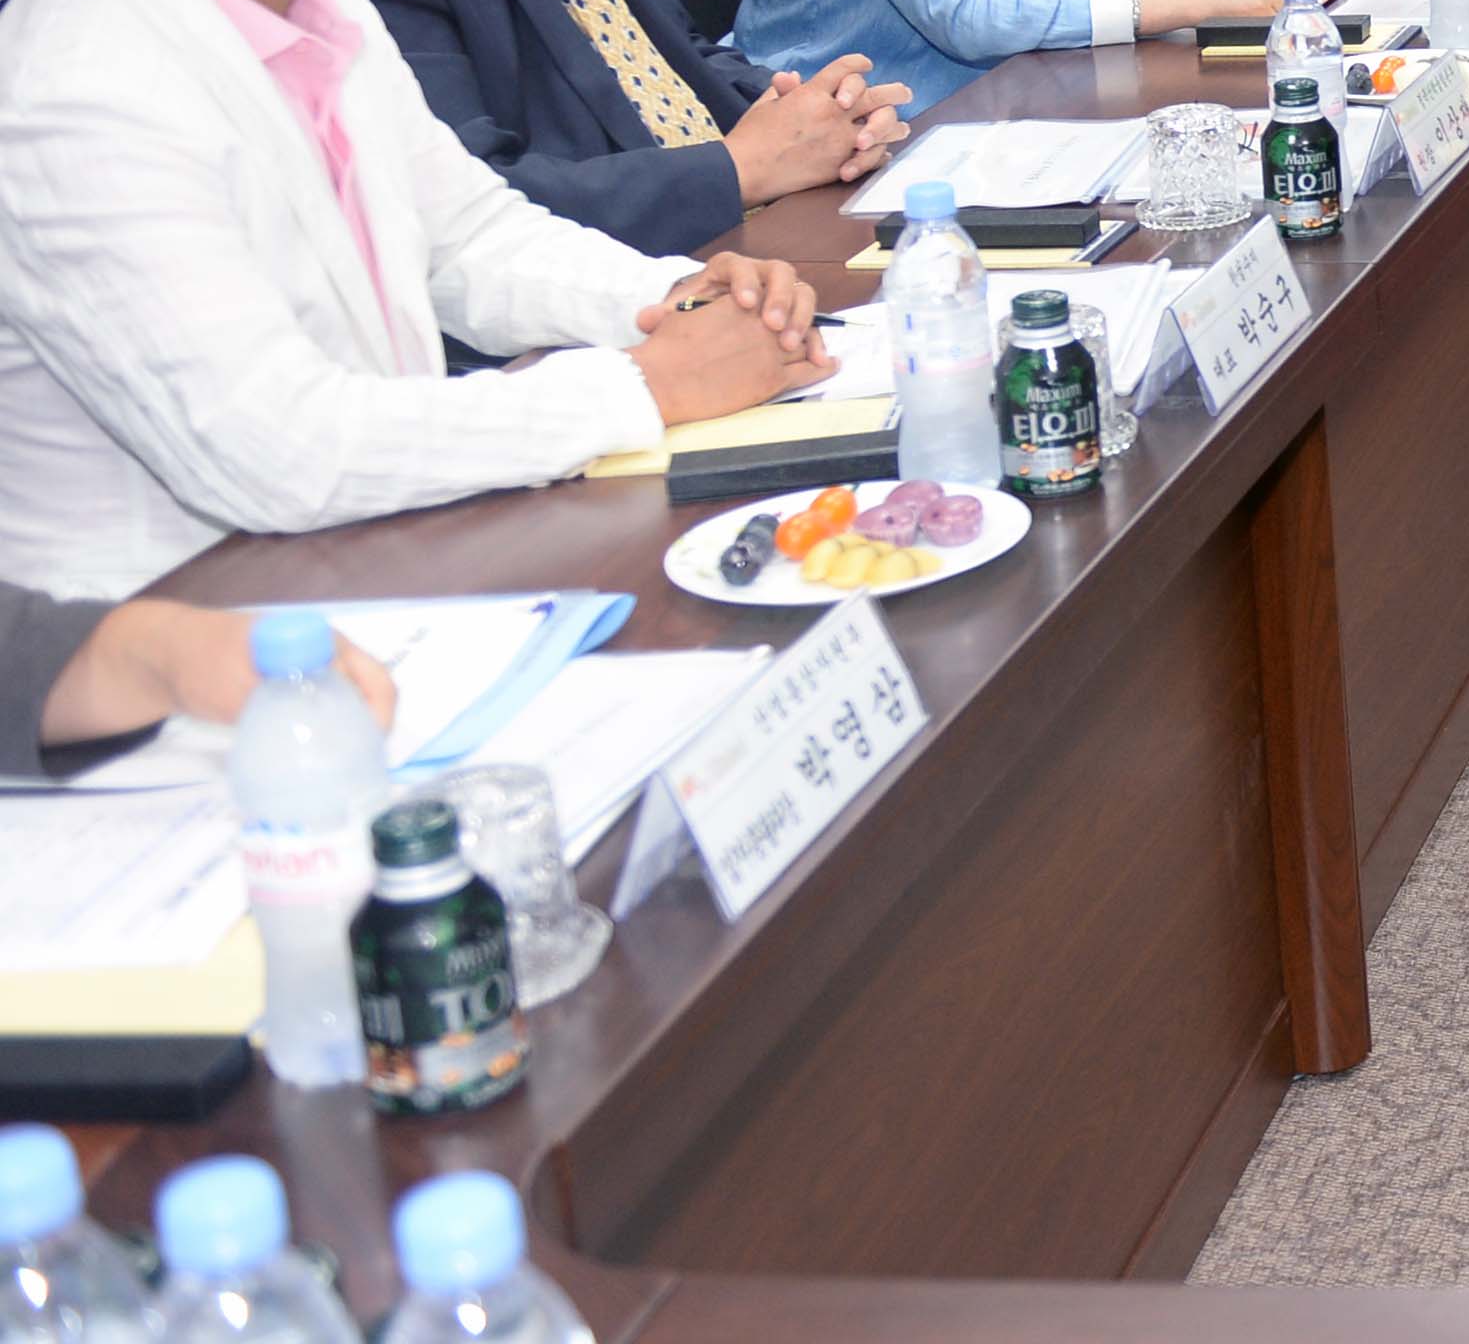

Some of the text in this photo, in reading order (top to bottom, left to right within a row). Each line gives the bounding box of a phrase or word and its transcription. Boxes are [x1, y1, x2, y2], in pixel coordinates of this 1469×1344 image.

[1284, 151, 1328, 166] Maxim
[1236, 273, 1293, 345] 박순구
[1026, 383, 1083, 404] Maxim
[795, 665, 905, 787] 박영삼
